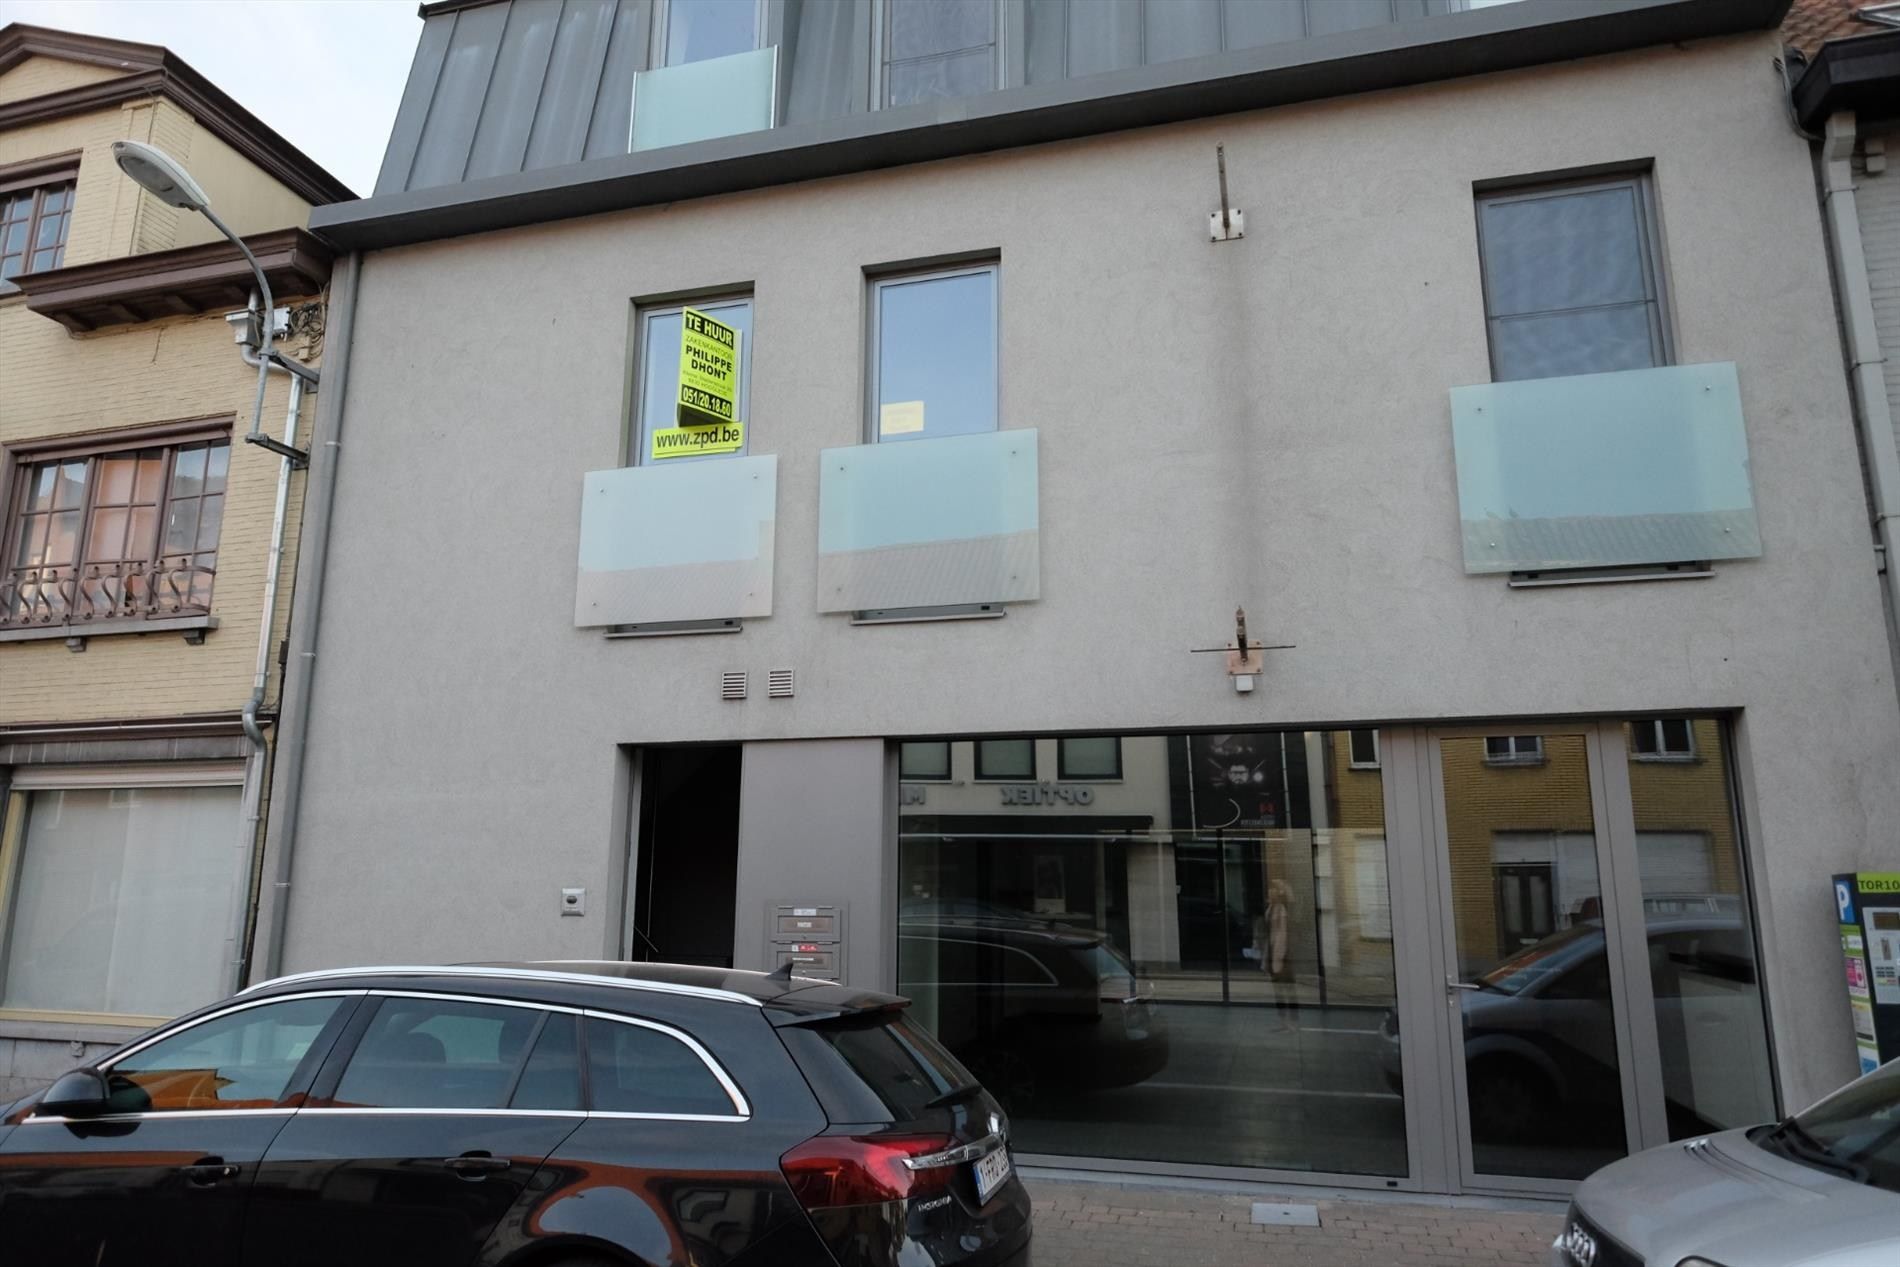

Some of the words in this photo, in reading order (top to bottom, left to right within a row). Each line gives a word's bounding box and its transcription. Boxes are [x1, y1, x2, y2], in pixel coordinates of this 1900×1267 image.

[687, 313, 701, 332] TE
[703, 320, 733, 347] HUUR
[686, 344, 732, 372] PHILIPPE
[691, 358, 727, 380] DHONT
[656, 426, 740, 449] www.zpd.be
